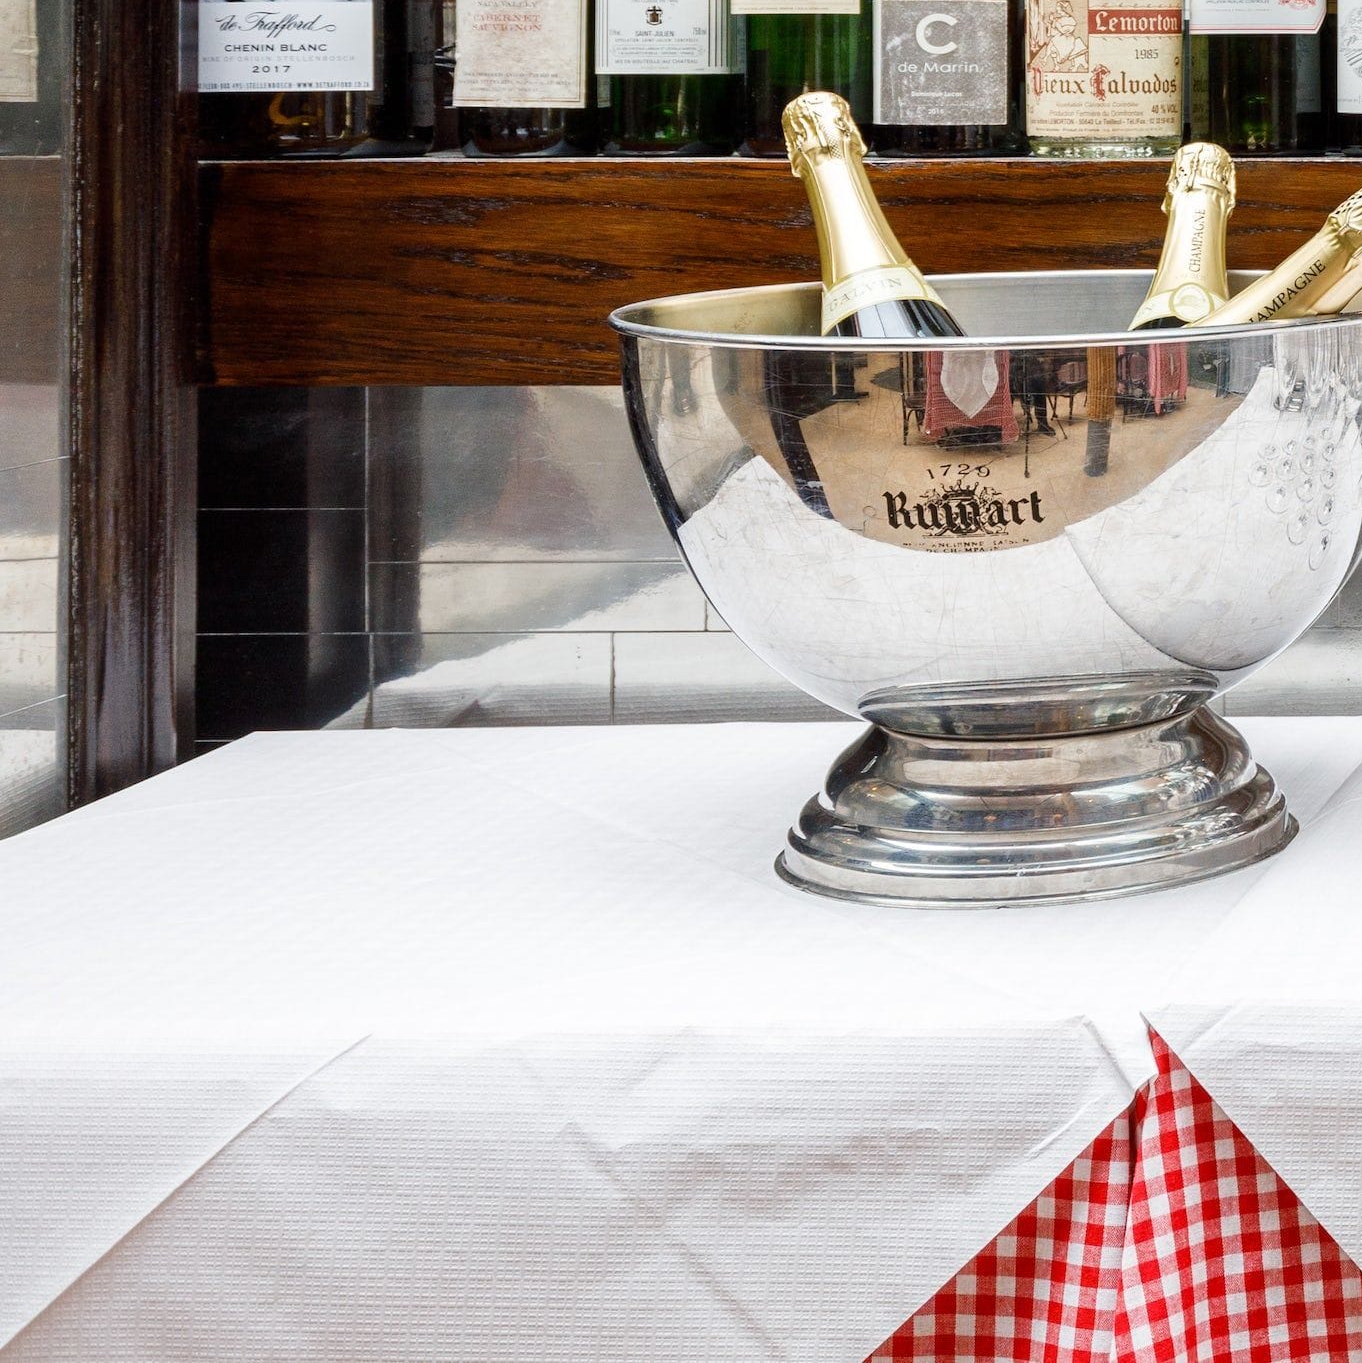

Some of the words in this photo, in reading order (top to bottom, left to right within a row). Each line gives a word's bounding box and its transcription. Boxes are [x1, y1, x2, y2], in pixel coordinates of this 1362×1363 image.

[1095, 10, 1178, 32] Lemorton
[915, 12, 959, 55] C
[224, 43, 275, 53] CHENIN
[280, 43, 328, 53] BLANC
[1134, 48, 1159, 60] 1985
[251, 65, 292, 74] 2017
[897, 61, 918, 73] de
[923, 61, 979, 73] Marrin
[1187, 207, 1207, 274] CHAMPAGNE
[1248, 258, 1328, 323] AMPAGNE
[925, 462, 991, 480] 1729
